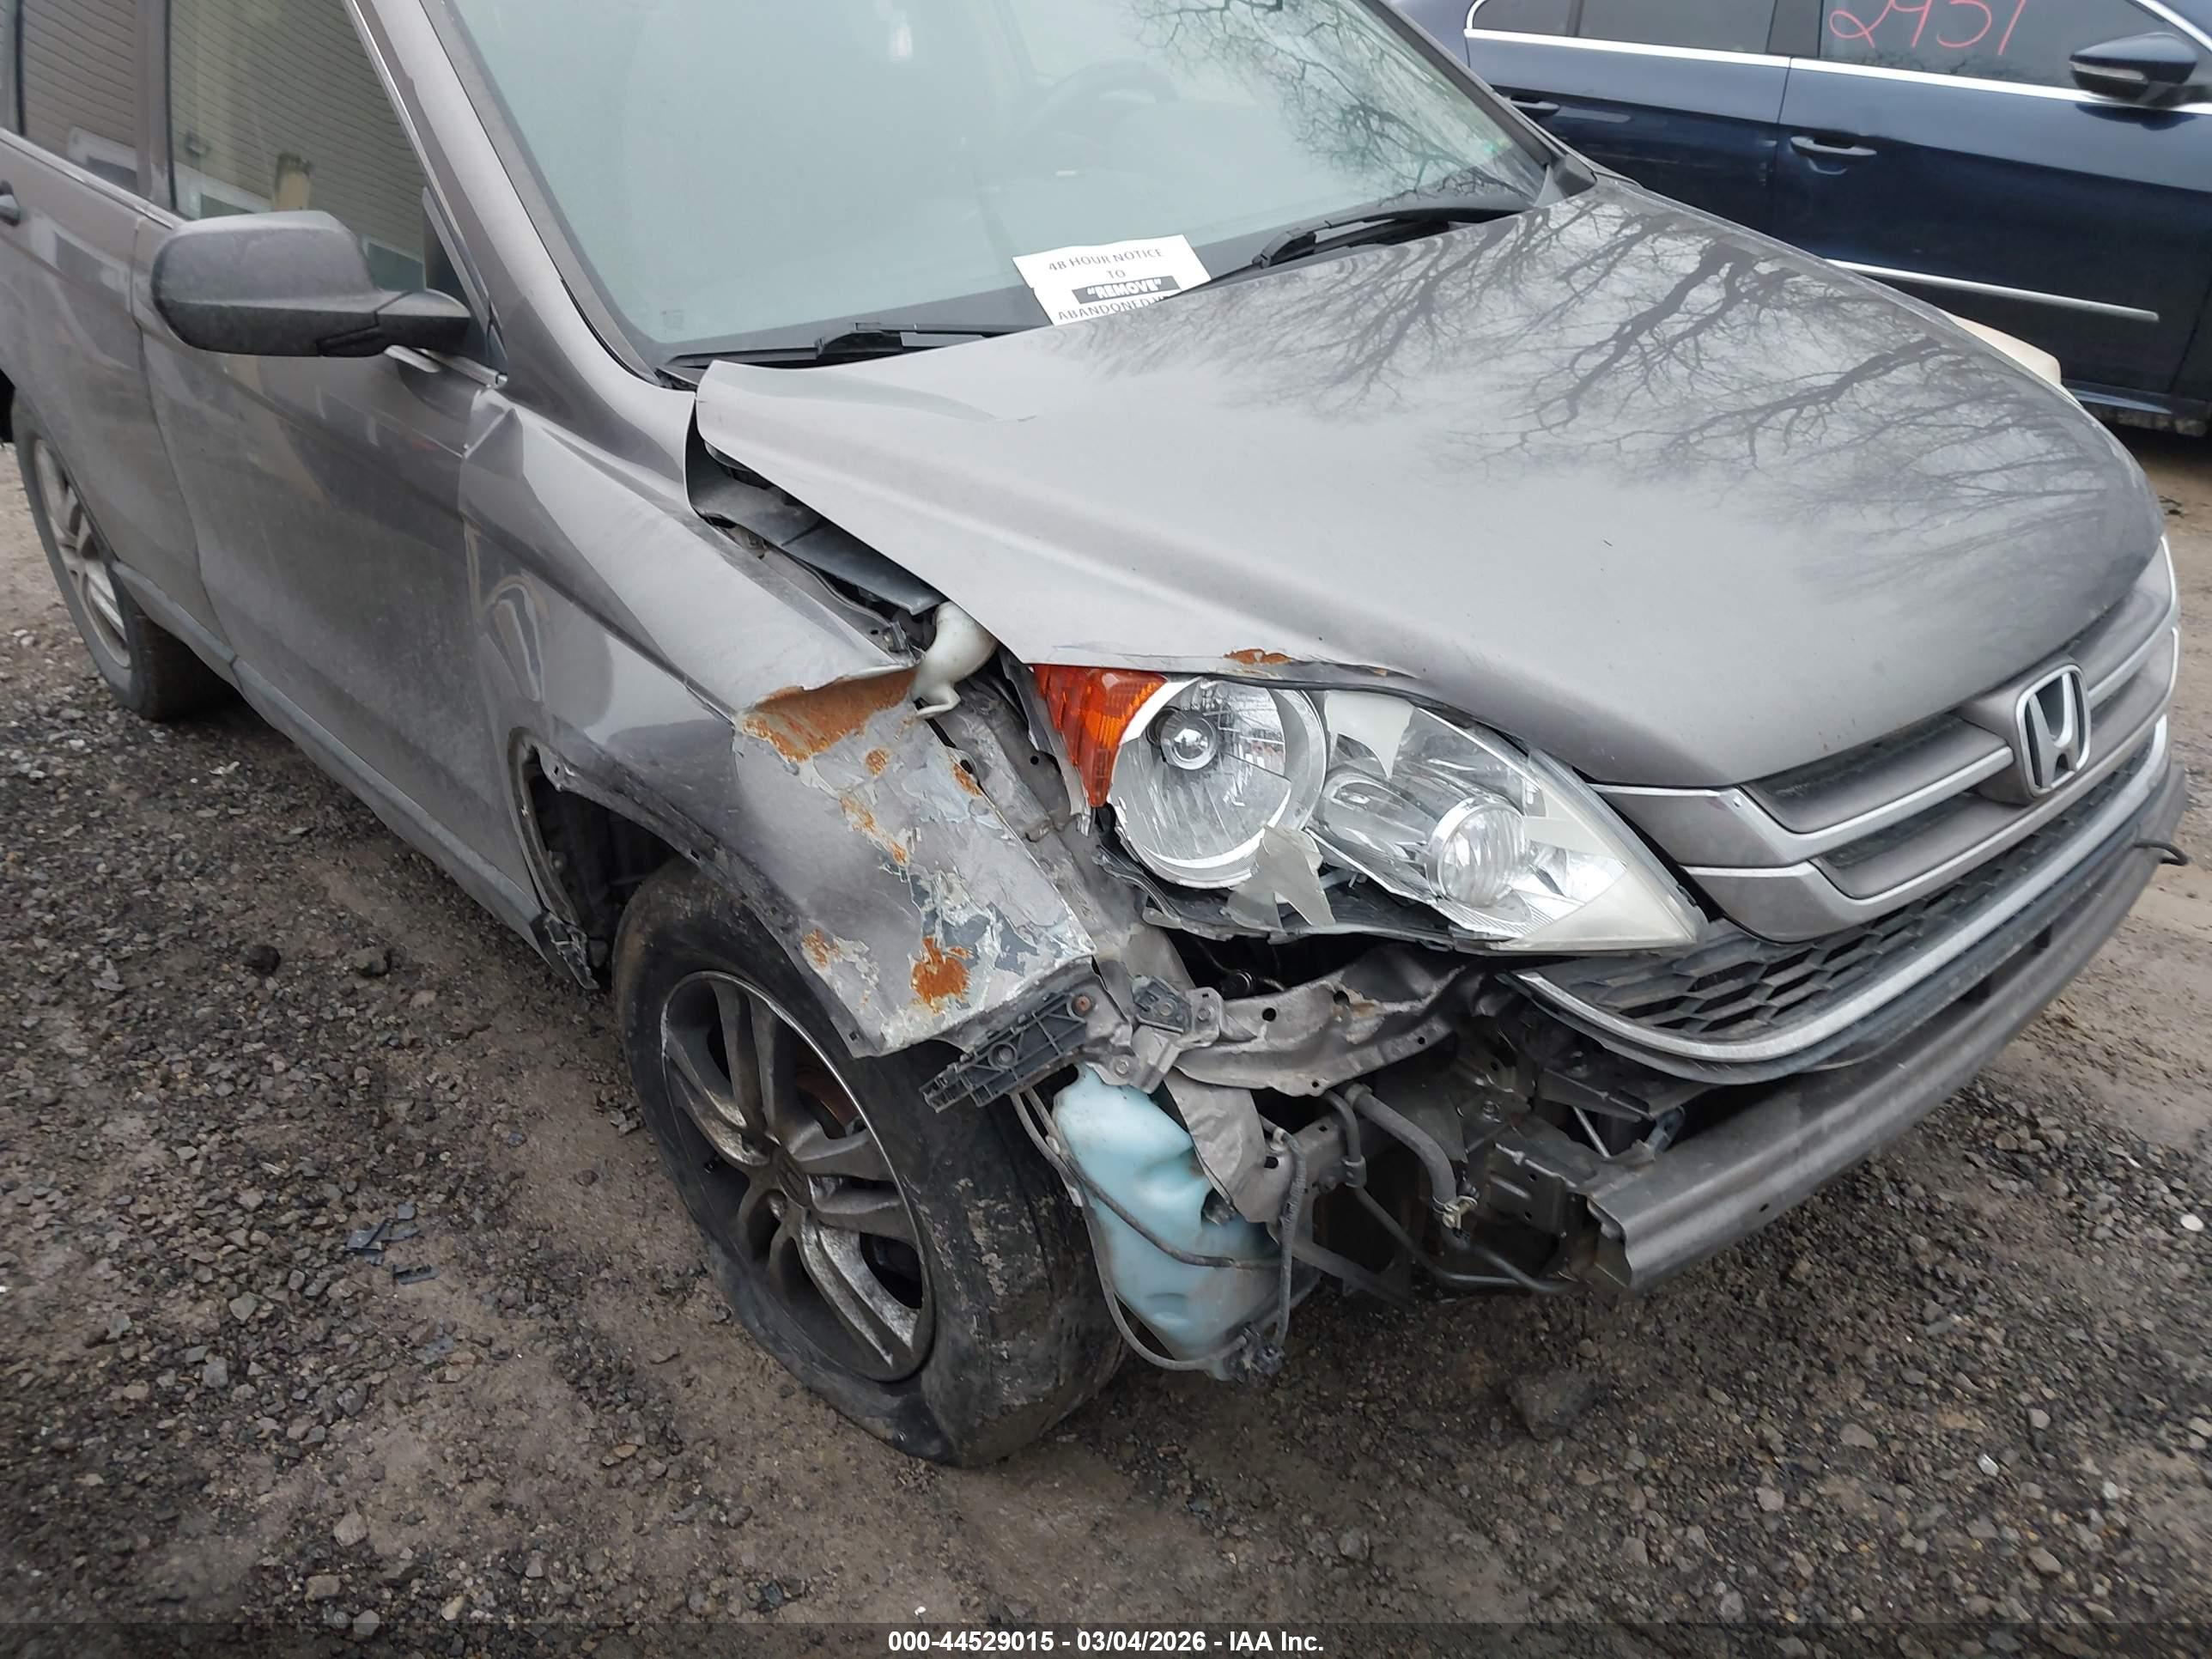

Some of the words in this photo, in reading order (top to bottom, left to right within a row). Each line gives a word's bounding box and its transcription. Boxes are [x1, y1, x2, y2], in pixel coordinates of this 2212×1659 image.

[1048, 261, 1067, 271] 48
[1069, 255, 1112, 268] HOUR
[1113, 248, 1163, 263] NOTICE
[1107, 269, 1127, 279] TO
[1058, 298, 1152, 320] ABANDONED
